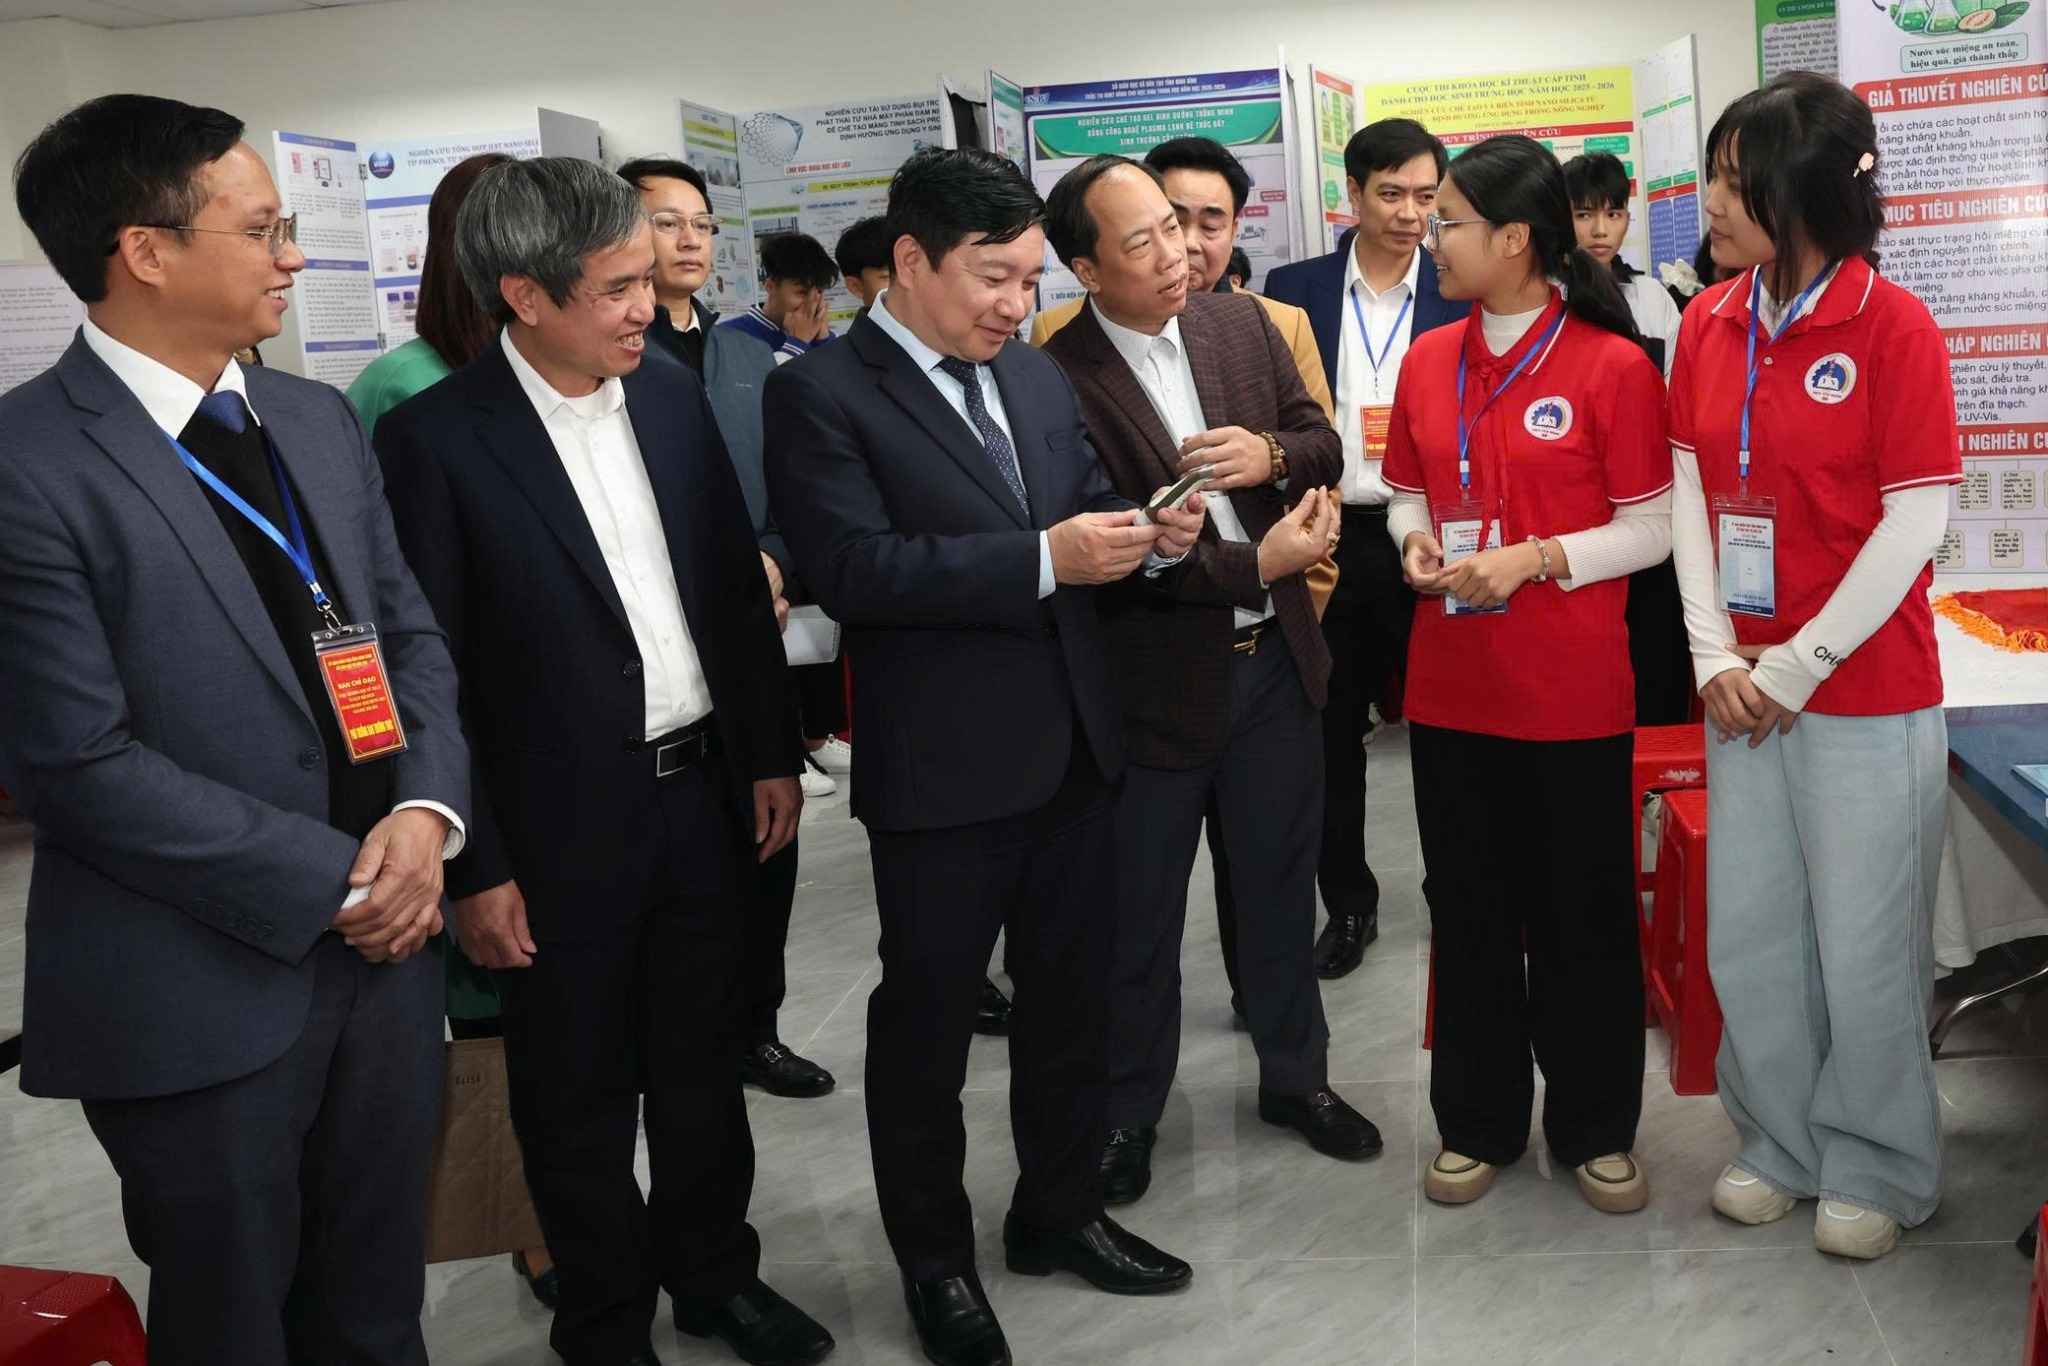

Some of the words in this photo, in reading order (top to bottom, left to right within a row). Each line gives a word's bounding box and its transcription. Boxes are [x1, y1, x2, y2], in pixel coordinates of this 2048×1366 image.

[1868, 82, 1894, 108] GIẢ
[1899, 77, 1956, 104] THUYẾT
[1961, 73, 2022, 98] NGHIÊN
[1936, 117, 1955, 129] các
[1956, 114, 1981, 128] hoạt
[1983, 109, 2006, 123] chất
[1906, 128, 1937, 145] kháng
[1936, 139, 1968, 154] kháng
[1969, 134, 2001, 149] khuẩn
[1906, 177, 1923, 190] kết
[1920, 197, 1954, 221] TIÊU
[1958, 194, 2020, 218] NGHIÊN
[1888, 248, 1907, 260] xác
[1908, 246, 1930, 260] định
[1932, 243, 1970, 259] nguyên
[1900, 257, 1922, 271] tích
[1924, 258, 1944, 270] các
[1945, 255, 1972, 270] hoạt
[1914, 269, 1933, 281] làm
[1967, 266, 1986, 278] cho
[1968, 287, 2001, 304] kháng
[1932, 302, 1962, 317] phẩm
[1963, 301, 1993, 314] nước
[1994, 300, 2013, 312] súc
[2014, 298, 2047, 314] miệng
[1945, 332, 1976, 354] HÁP
[1981, 328, 2041, 353] NGHIÊN
[1968, 429, 2029, 452] NGHIÊN
